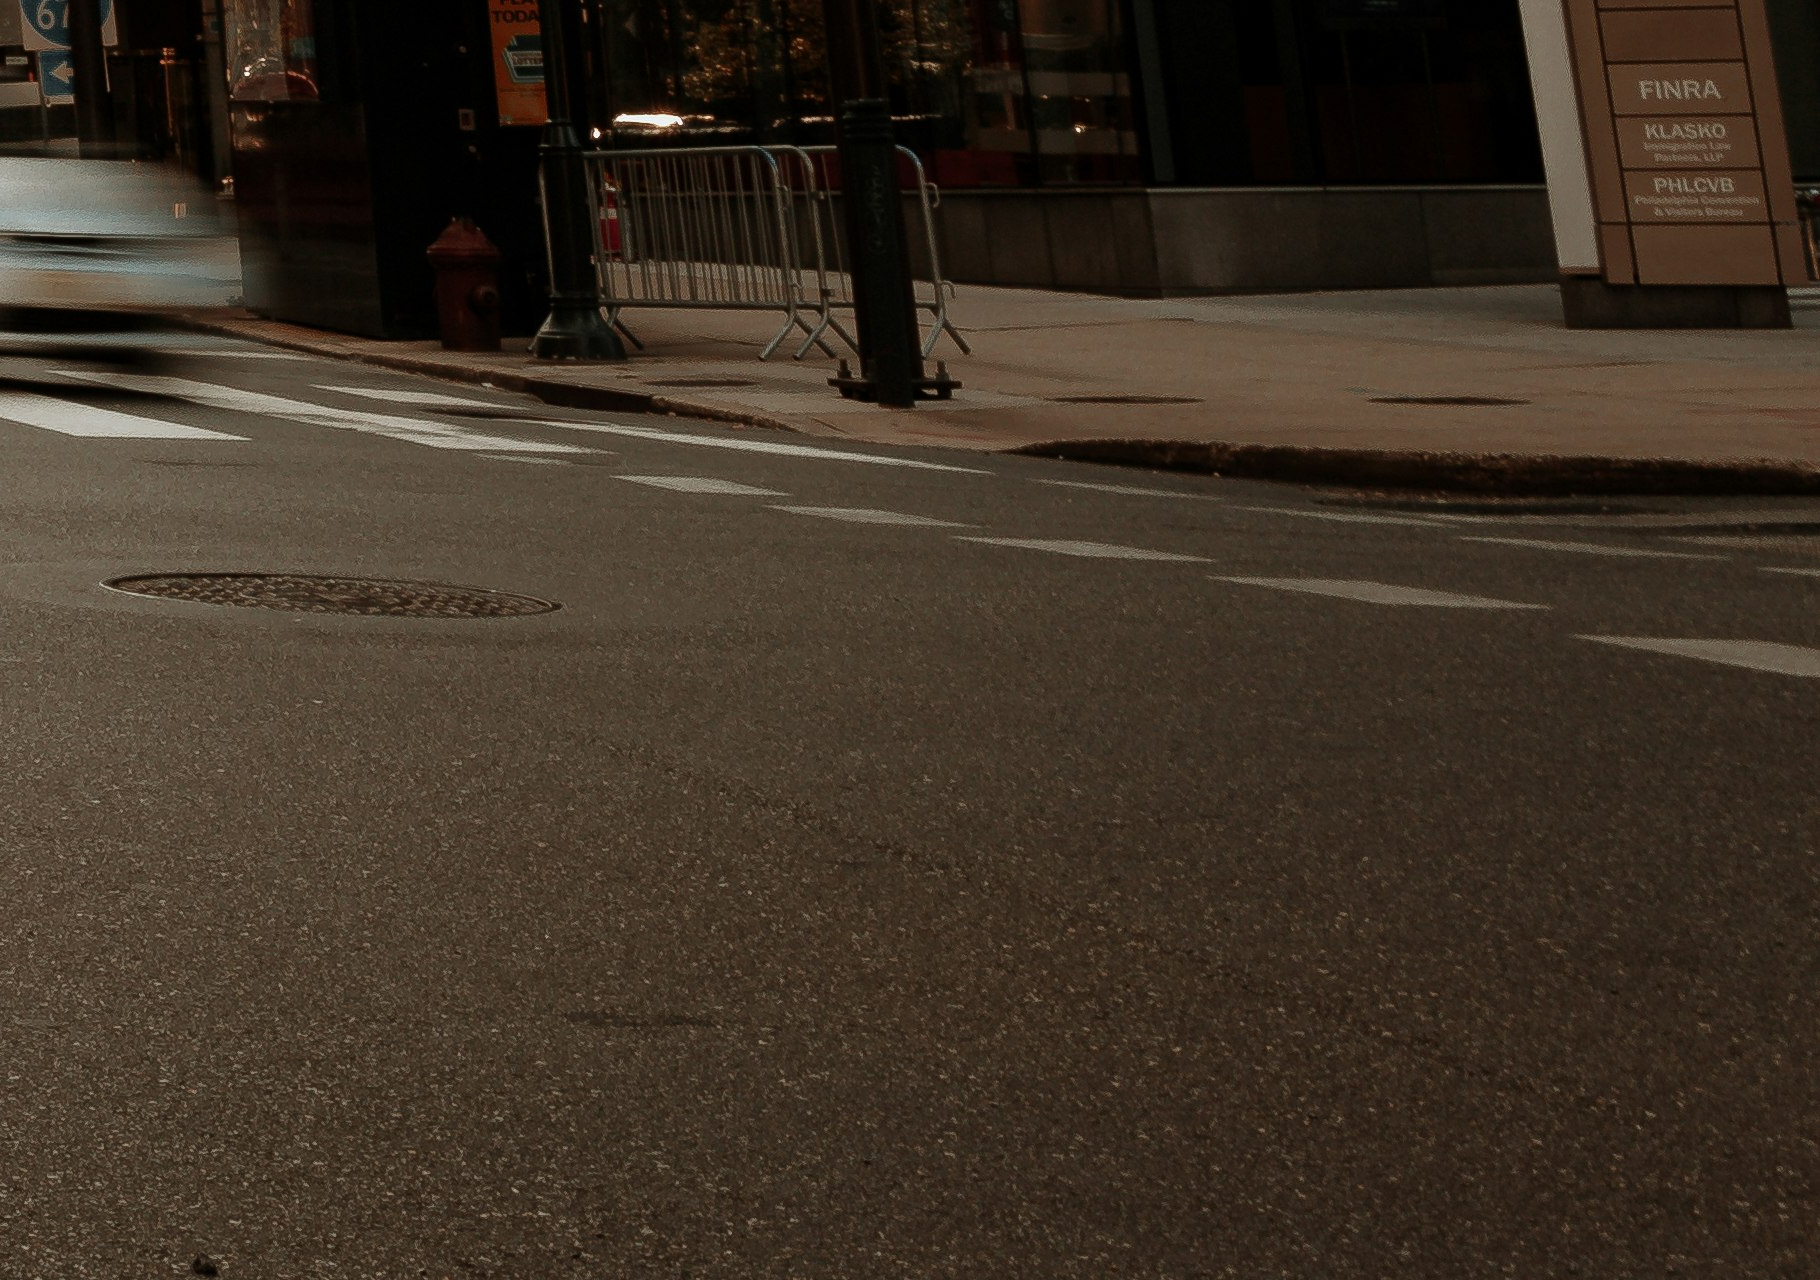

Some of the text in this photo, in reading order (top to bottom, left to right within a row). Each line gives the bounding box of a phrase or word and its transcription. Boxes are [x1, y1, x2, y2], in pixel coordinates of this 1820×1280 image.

[491, 9, 541, 24] TODA
[1638, 79, 1722, 100] FINRA
[1644, 123, 1727, 140] KLASKO
[1653, 177, 1735, 194] PHLCVB
